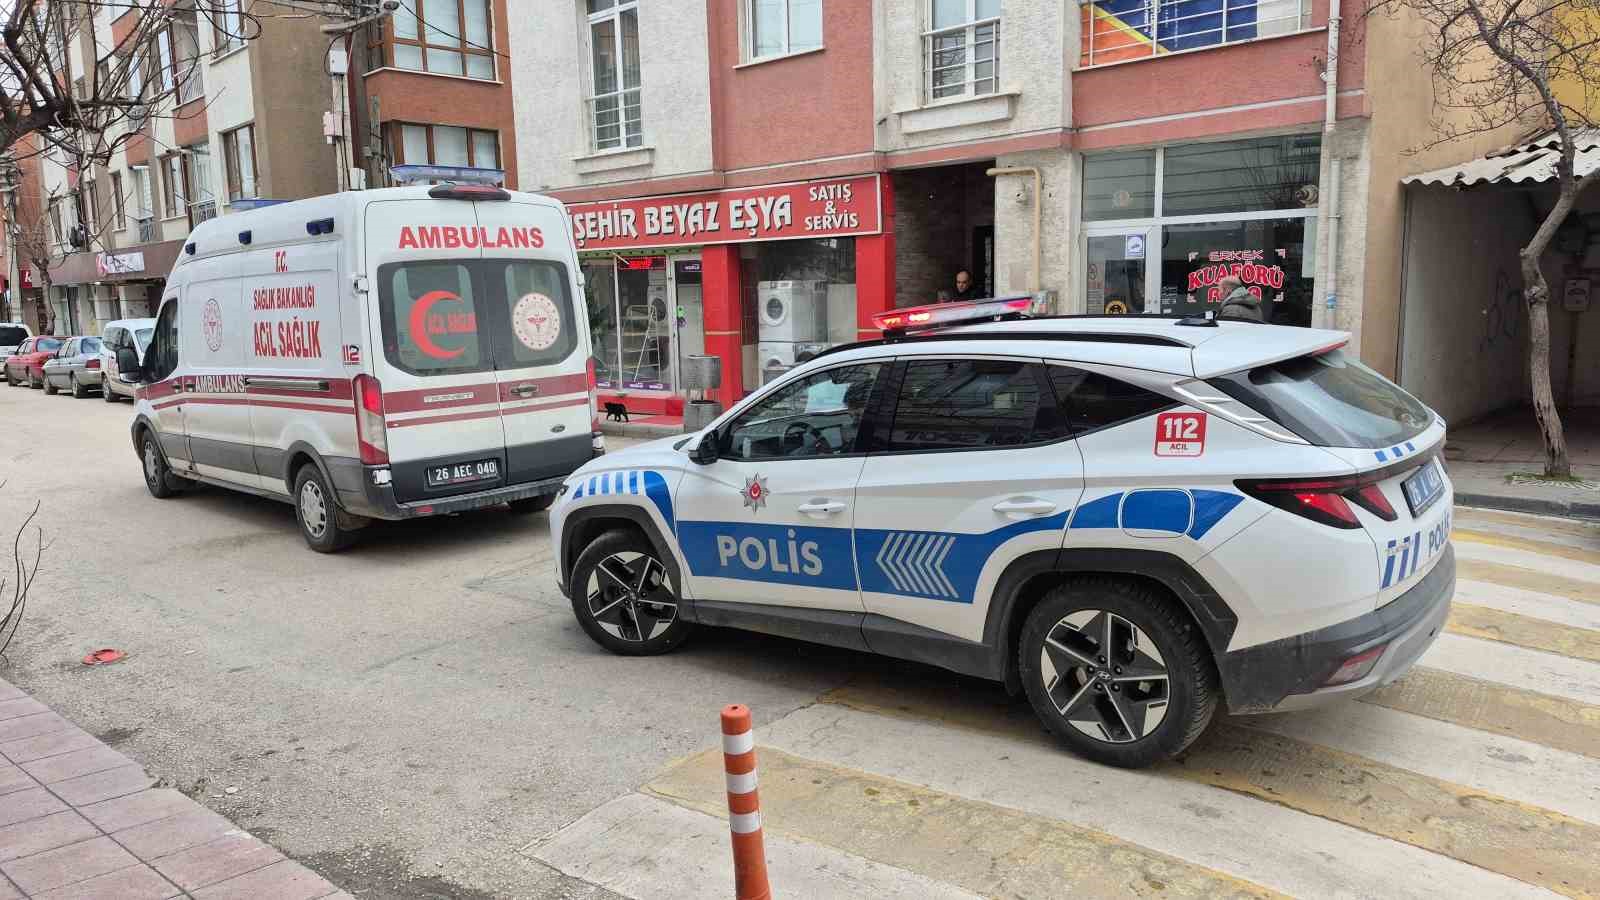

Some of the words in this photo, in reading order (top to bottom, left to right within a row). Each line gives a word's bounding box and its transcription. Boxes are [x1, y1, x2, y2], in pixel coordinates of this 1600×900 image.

[809, 183, 852, 202] SATIŞ
[643, 200, 720, 237] BEYAZ
[729, 194, 793, 238] EŞYA
[824, 200, 837, 215] &
[804, 209, 859, 231] SERVİS
[398, 226, 545, 249] AMBULANS
[275, 250, 288, 272] T.C.
[1208, 249, 1264, 261] ERKEK
[1188, 260, 1284, 289] KUAFÖRÜ
[253, 286, 276, 310] SAĞLIK
[276, 283, 315, 309] BAKANLIĞI
[278, 315, 322, 358] SAĞLIK
[342, 344, 360, 361] 112
[195, 375, 246, 392] AMBULANS
[1164, 417, 1199, 439] 112
[435, 467, 449, 481] 26
[454, 464, 473, 478] AEC
[477, 461, 495, 475] 040
[717, 528, 823, 576] POLİS
